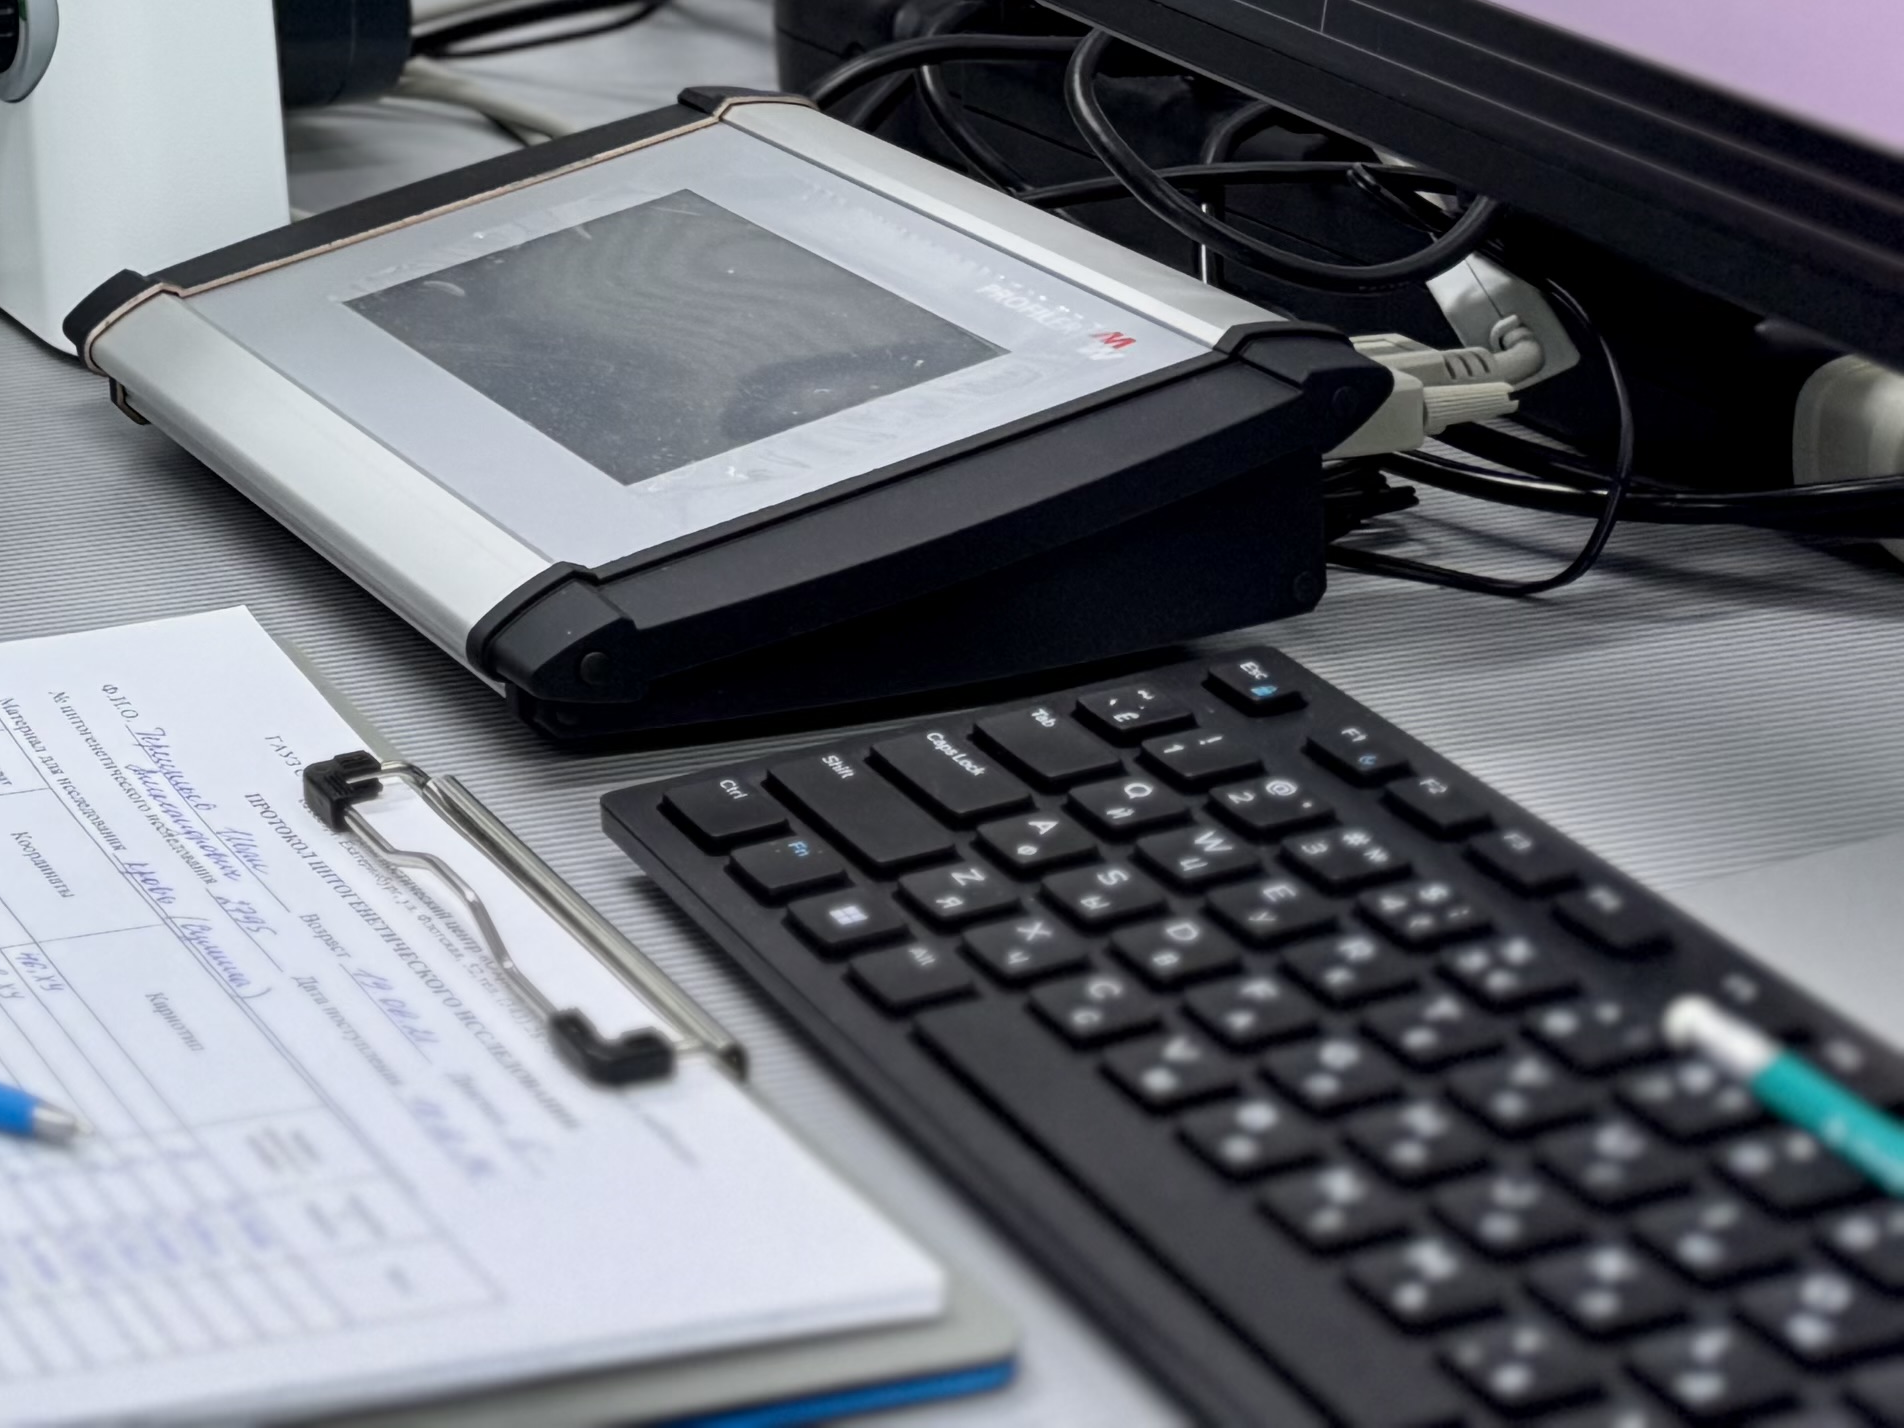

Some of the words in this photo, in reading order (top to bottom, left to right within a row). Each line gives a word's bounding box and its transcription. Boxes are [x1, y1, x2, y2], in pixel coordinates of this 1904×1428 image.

[1240, 661, 1269, 680] Esc
[101, 683, 139, 723] Ф.И.О.
[1031, 708, 1057, 728] Tab
[925, 731, 955, 757] Caps
[951, 752, 987, 777] Lock
[821, 753, 855, 780] Shift
[60, 704, 149, 814] цитогенетического
[145, 813, 218, 886] исследования
[719, 778, 748, 800] Ctrl
[1123, 781, 1154, 800] Q
[1228, 791, 1255, 804] 2
[1265, 779, 1298, 796] @
[40, 756, 64, 777] для
[57, 777, 127, 853] исследования
[1028, 819, 1059, 835] A
[788, 840, 809, 857] Fn
[1194, 830, 1233, 853] W
[10, 830, 75, 899] Координаты
[950, 867, 986, 887] Z
[1096, 868, 1131, 886] S
[244, 792, 315, 865] ПРОТОКОЛ
[308, 858, 463, 1008] ЦИТОГЕНЕТИЧЕСКОГО
[1262, 882, 1298, 902] E
[935, 896, 964, 909] Я
[299, 913, 351, 960] Возраст
[1016, 921, 1051, 941] X
[1165, 922, 1200, 941] D
[909, 946, 936, 966] Alt
[145, 992, 205, 1052] Кариотип
[290, 974, 333, 1012] Дата
[326, 1006, 404, 1088] поступления
